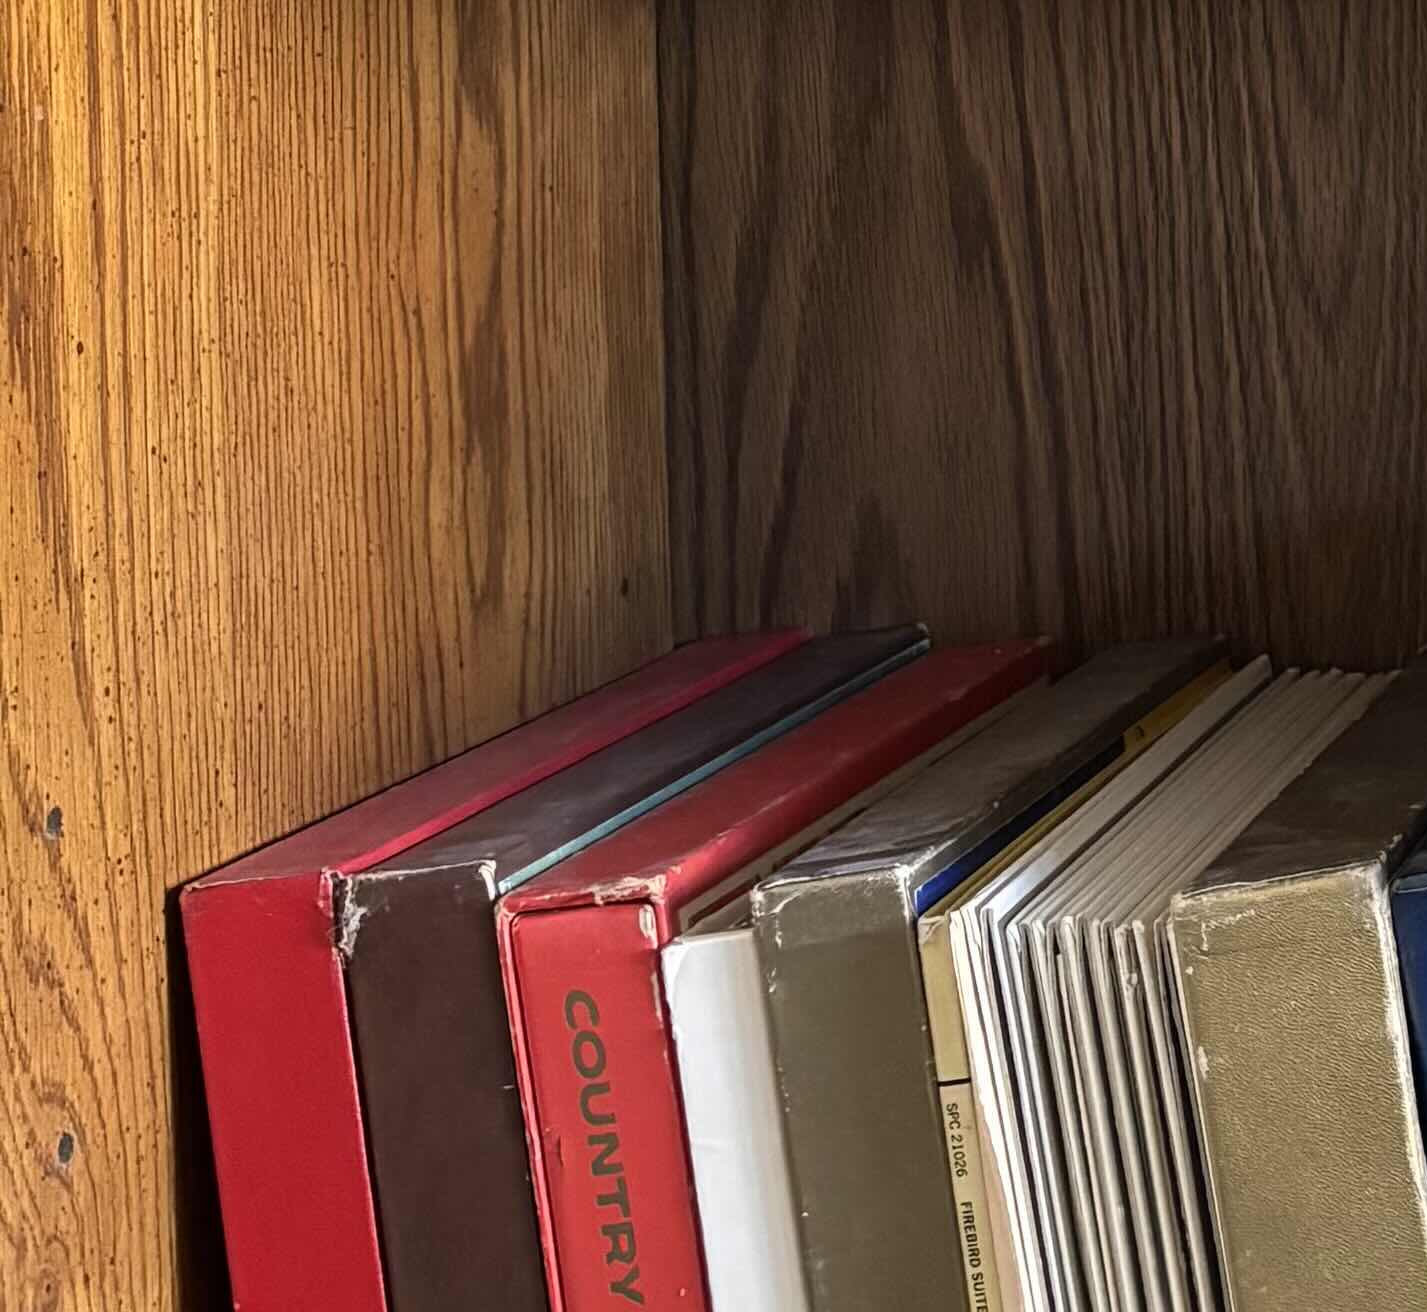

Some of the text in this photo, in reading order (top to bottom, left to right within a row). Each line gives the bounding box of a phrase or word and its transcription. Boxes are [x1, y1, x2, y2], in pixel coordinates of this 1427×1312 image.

[945, 1103, 960, 1130] SPC
[563, 988, 651, 1306] COUNTRY
[950, 1133, 969, 1178] 21026
[961, 1201, 982, 1267] FIREBIRD
